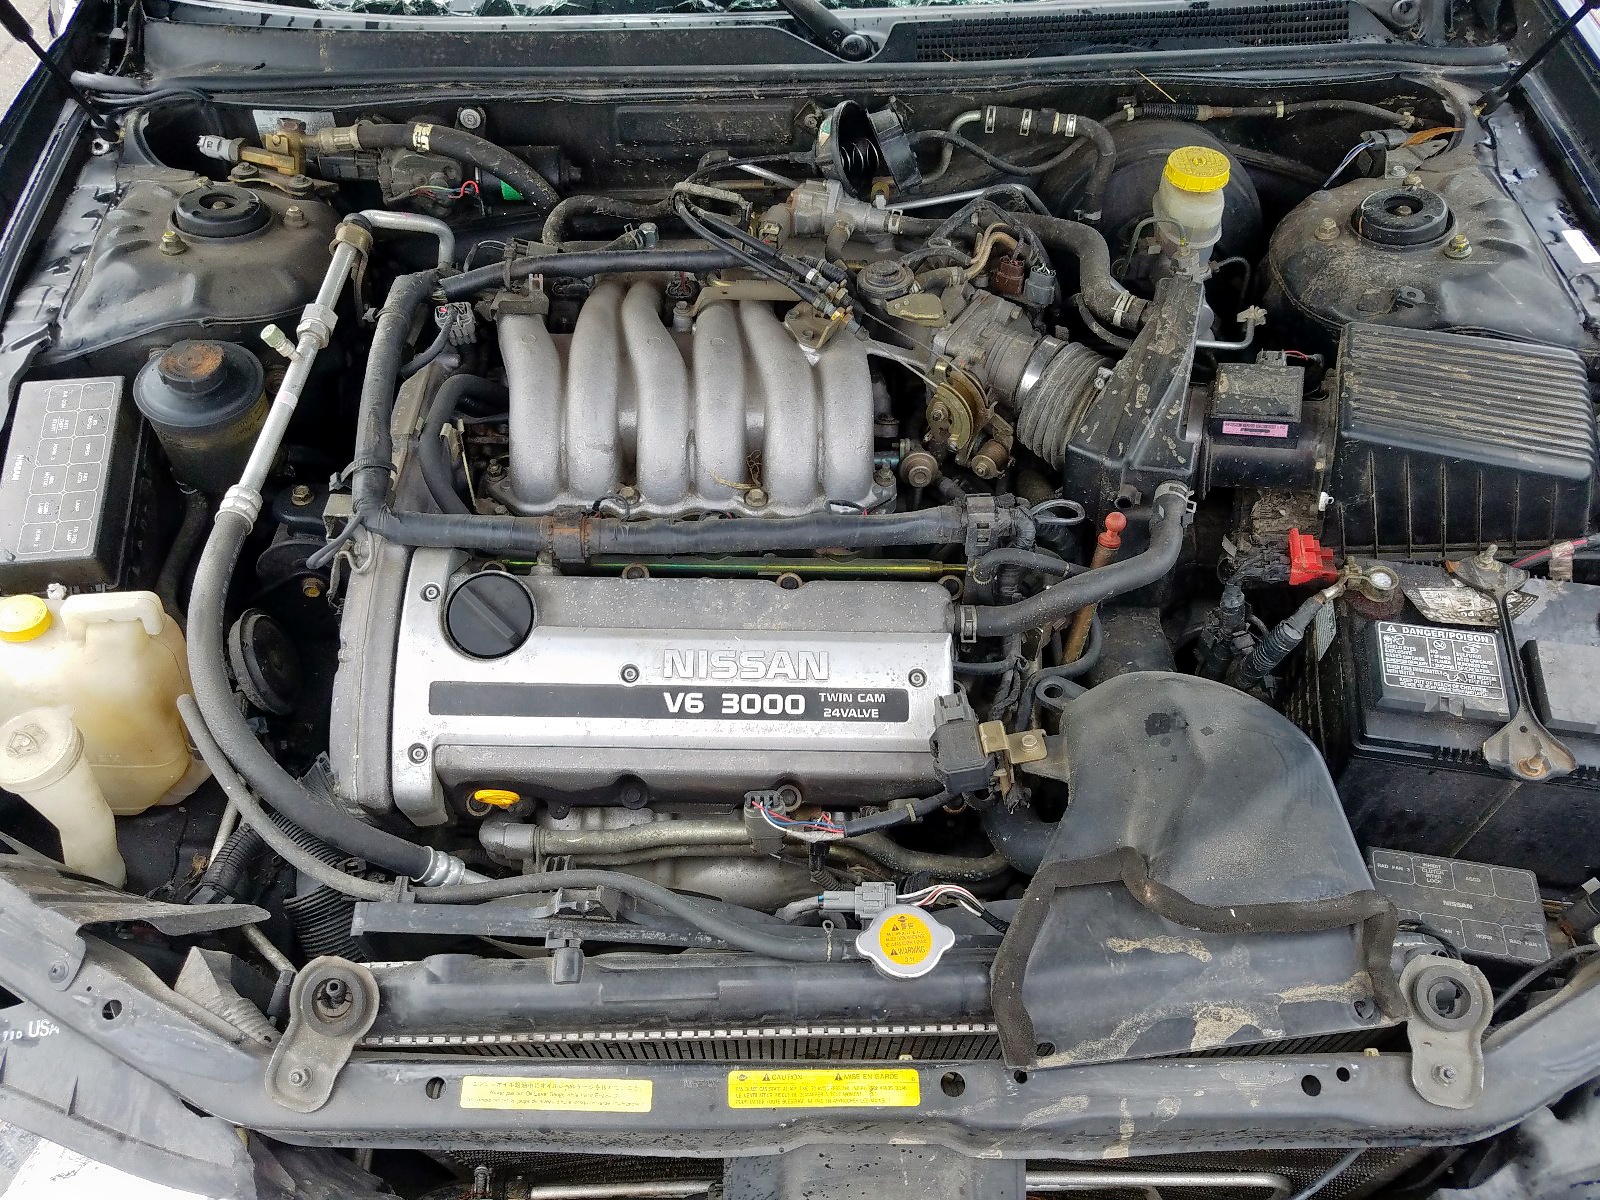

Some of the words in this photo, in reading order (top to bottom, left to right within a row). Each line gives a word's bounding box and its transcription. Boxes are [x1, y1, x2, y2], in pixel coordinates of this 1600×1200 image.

[12, 454, 24, 480] NISSAN
[1402, 627, 1489, 643] DANGER/POISON
[663, 649, 829, 680] NISSAN
[663, 693, 705, 713] V6
[721, 694, 806, 715] 3000
[819, 693, 853, 703] TWIN
[858, 694, 885, 703] CAM
[823, 708, 879, 718] 24VALVE
[1443, 900, 1473, 909] NISSAN
[29, 1018, 59, 1037] USA
